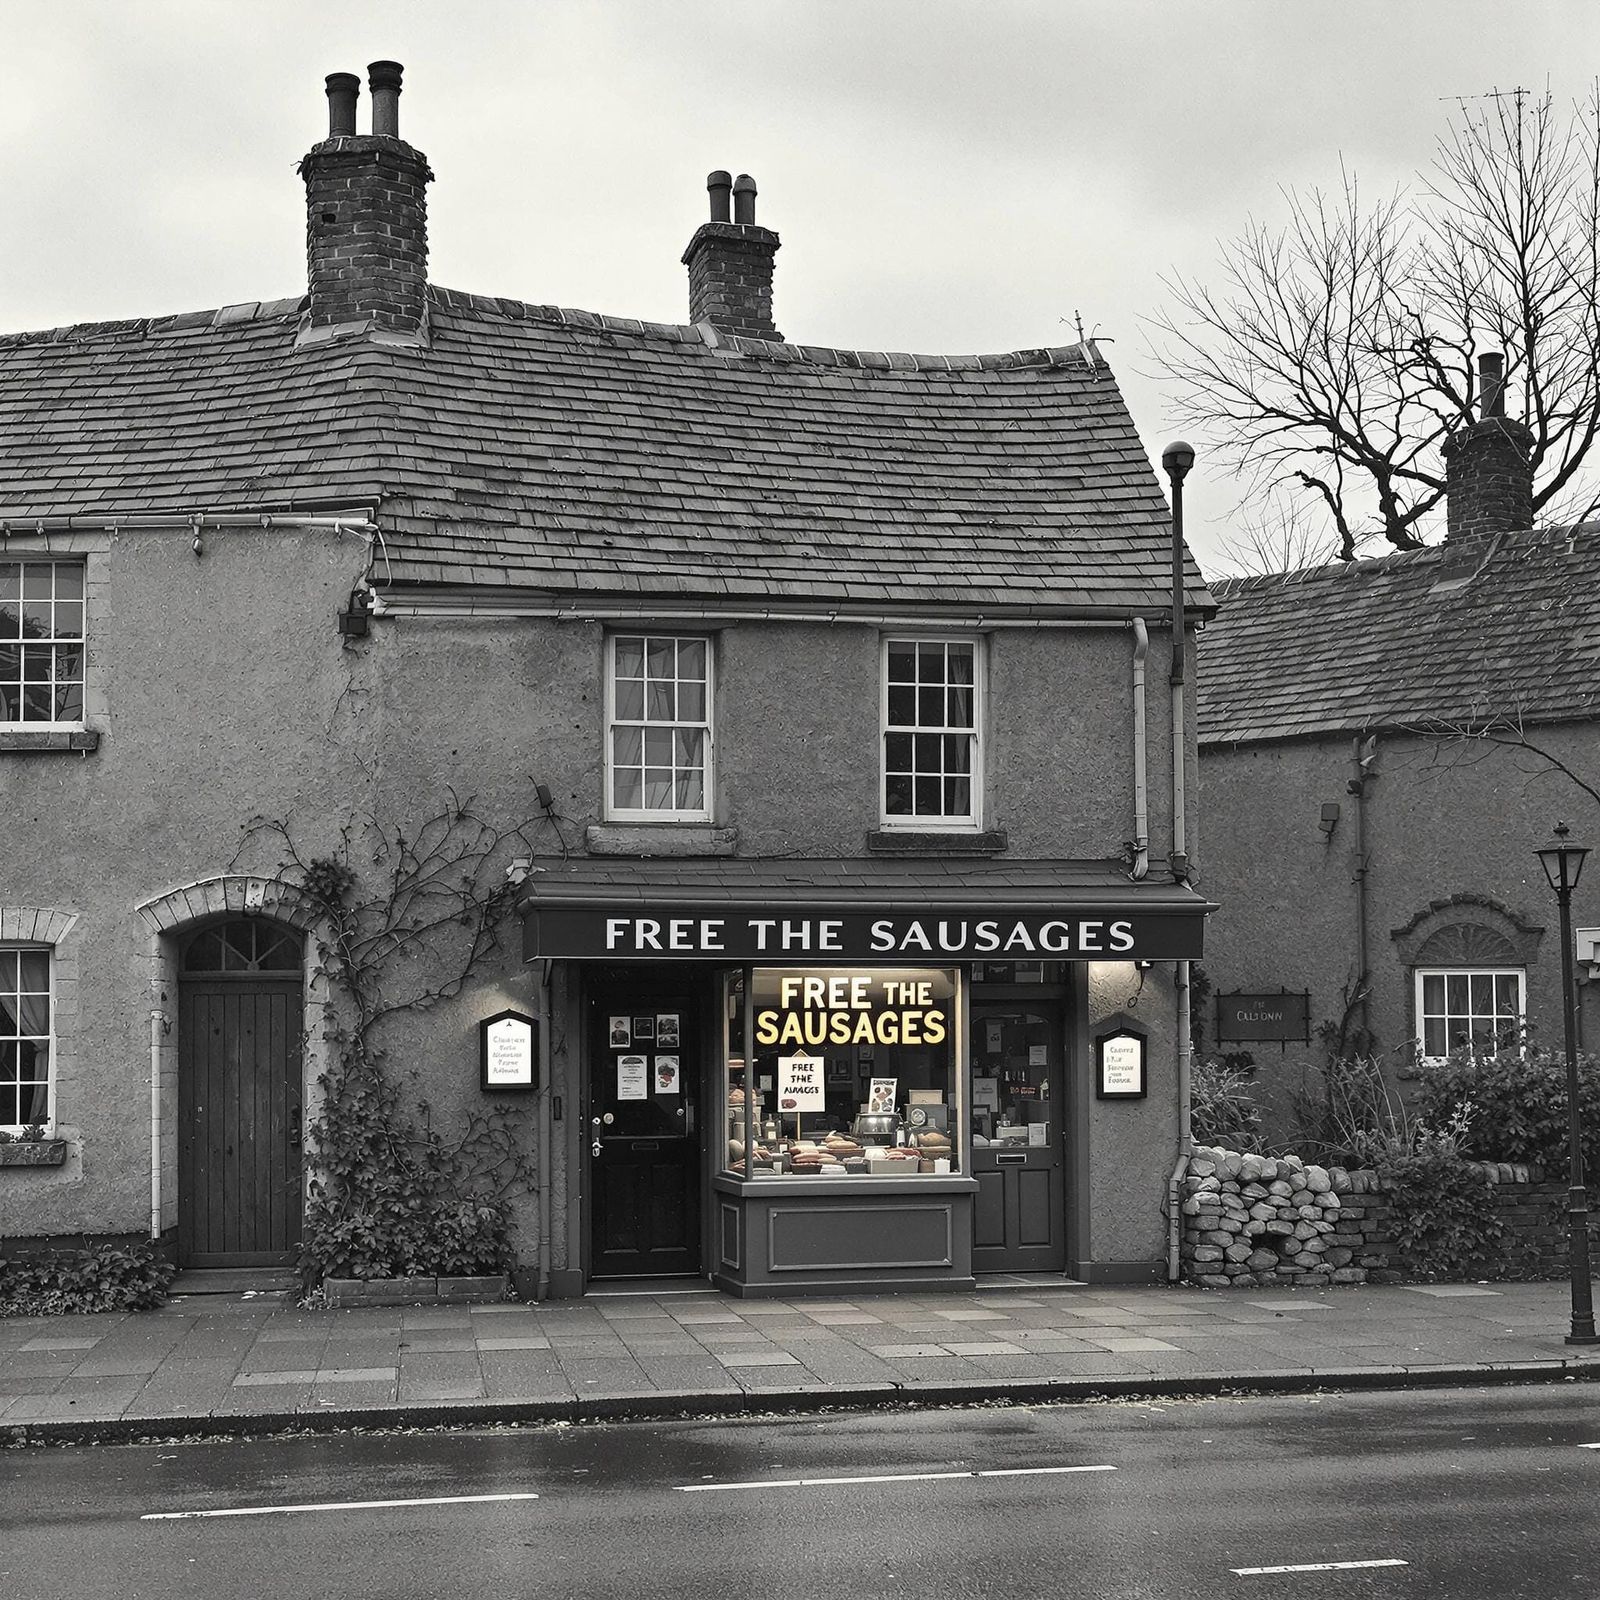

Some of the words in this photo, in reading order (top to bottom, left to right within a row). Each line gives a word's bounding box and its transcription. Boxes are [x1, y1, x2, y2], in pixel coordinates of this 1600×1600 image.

[606, 919, 725, 950] FREE
[747, 920, 843, 950] THE
[870, 921, 1135, 952] SAUSAGES
[781, 976, 873, 1009] FREE
[882, 981, 933, 1005] THE
[756, 1010, 946, 1045] SAUSAGES
[791, 1063, 815, 1072] FREE
